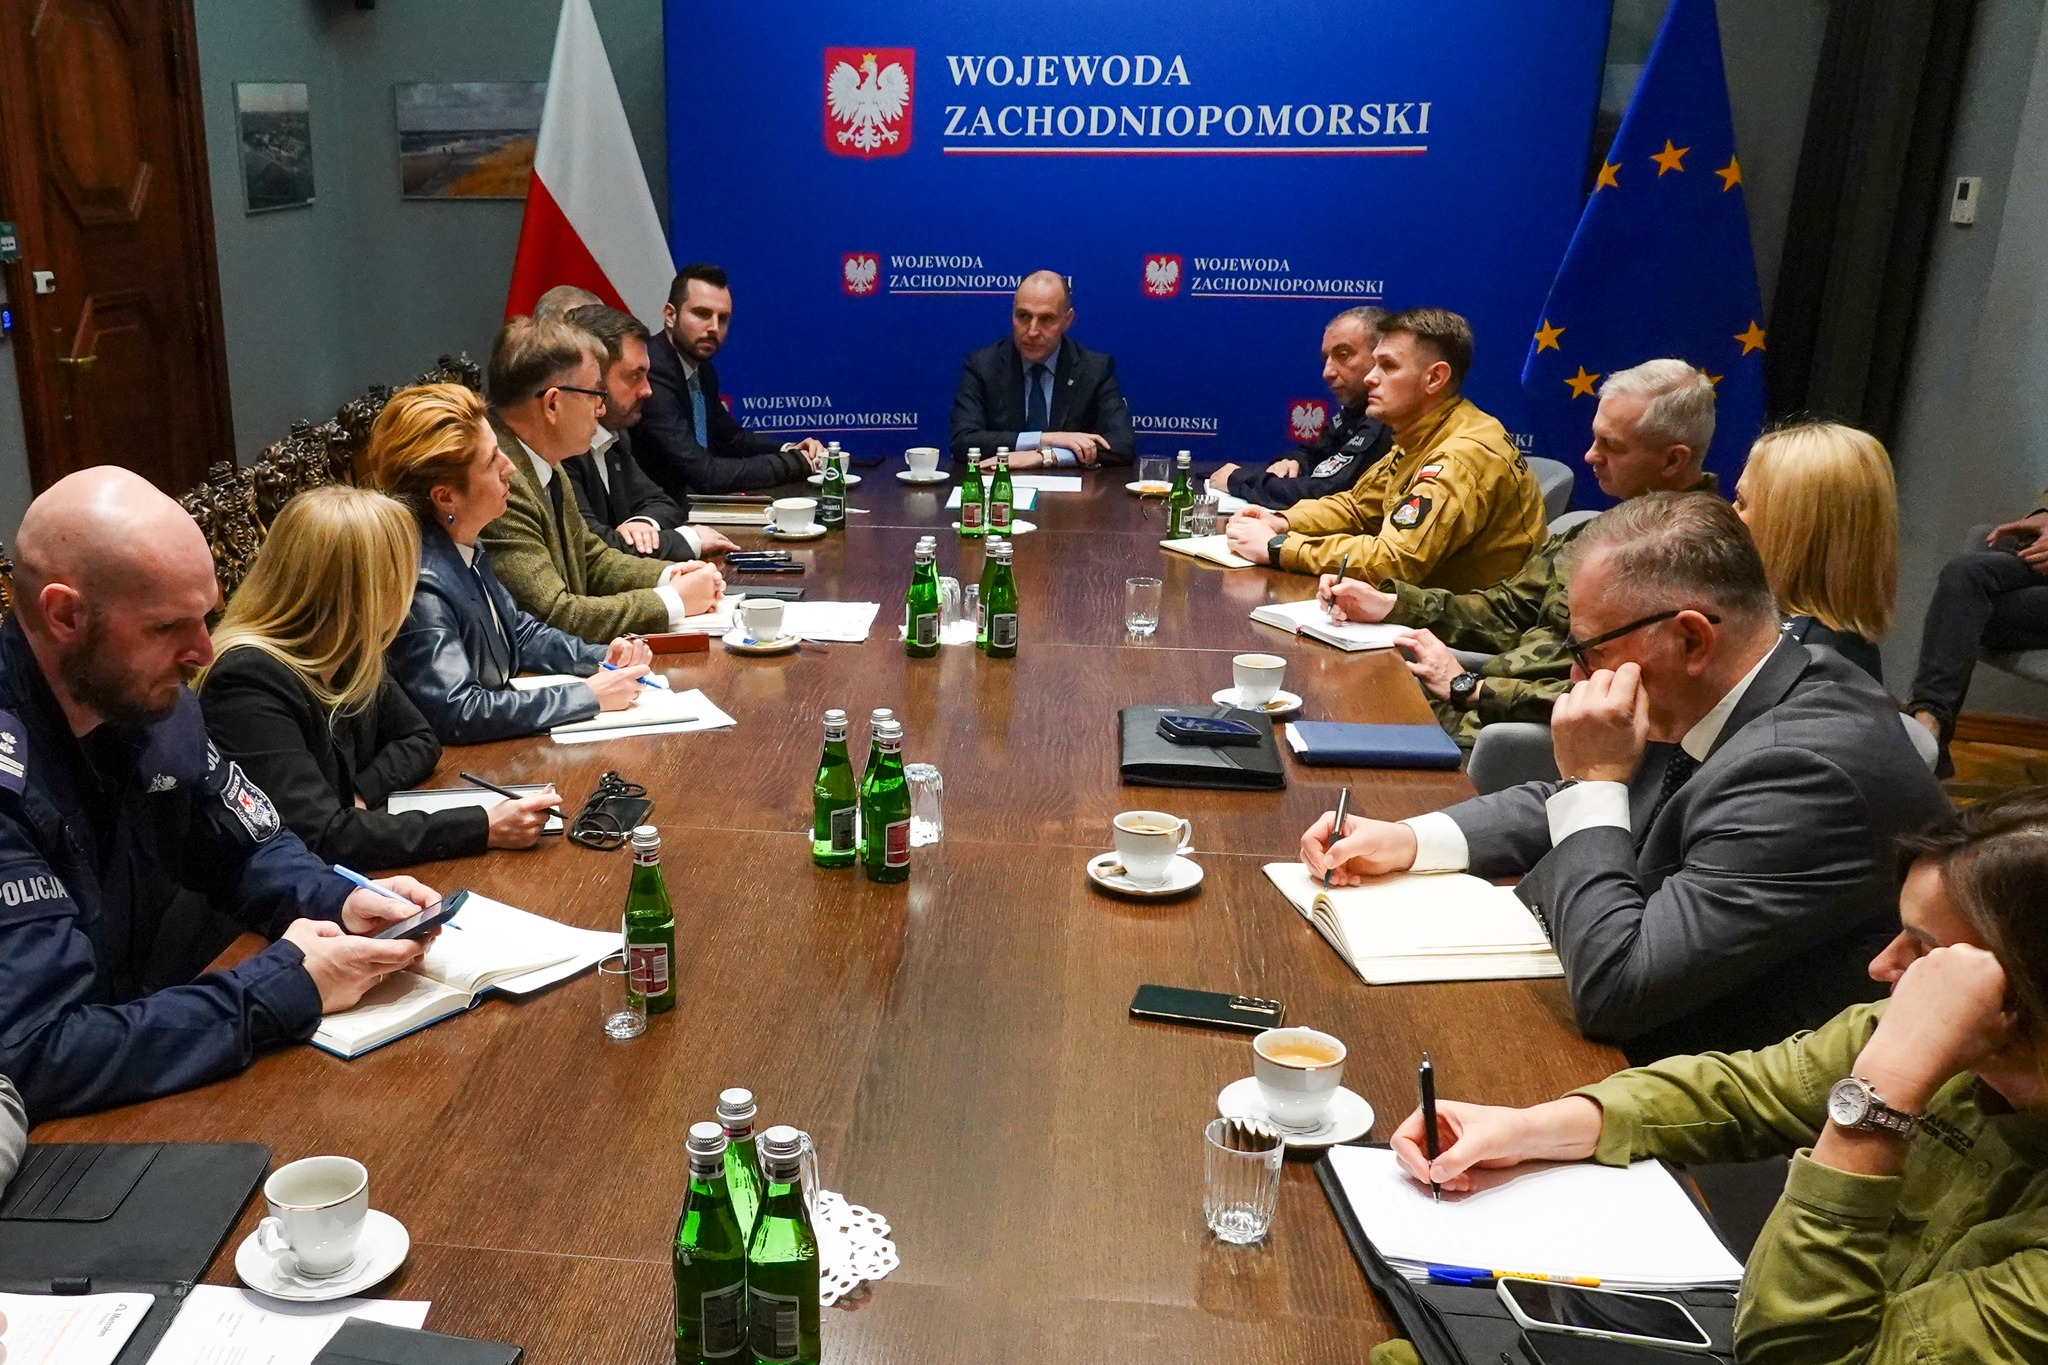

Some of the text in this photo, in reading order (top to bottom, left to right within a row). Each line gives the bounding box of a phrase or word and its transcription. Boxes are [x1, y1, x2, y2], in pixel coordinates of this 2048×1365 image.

[946, 55, 1191, 86] WOJEWODA
[943, 102, 1432, 137] ZACHODNIOPOMORSKI
[890, 255, 983, 269] WOJEWODA
[1193, 257, 1290, 272] WOJEWODA
[1191, 276, 1384, 294] ZACHODNIOPOMORSKI
[742, 395, 832, 410] WOJEWODA
[741, 412, 918, 429] ZACHODNIOPOMORSKI
[0, 876, 69, 907] OLICJA
